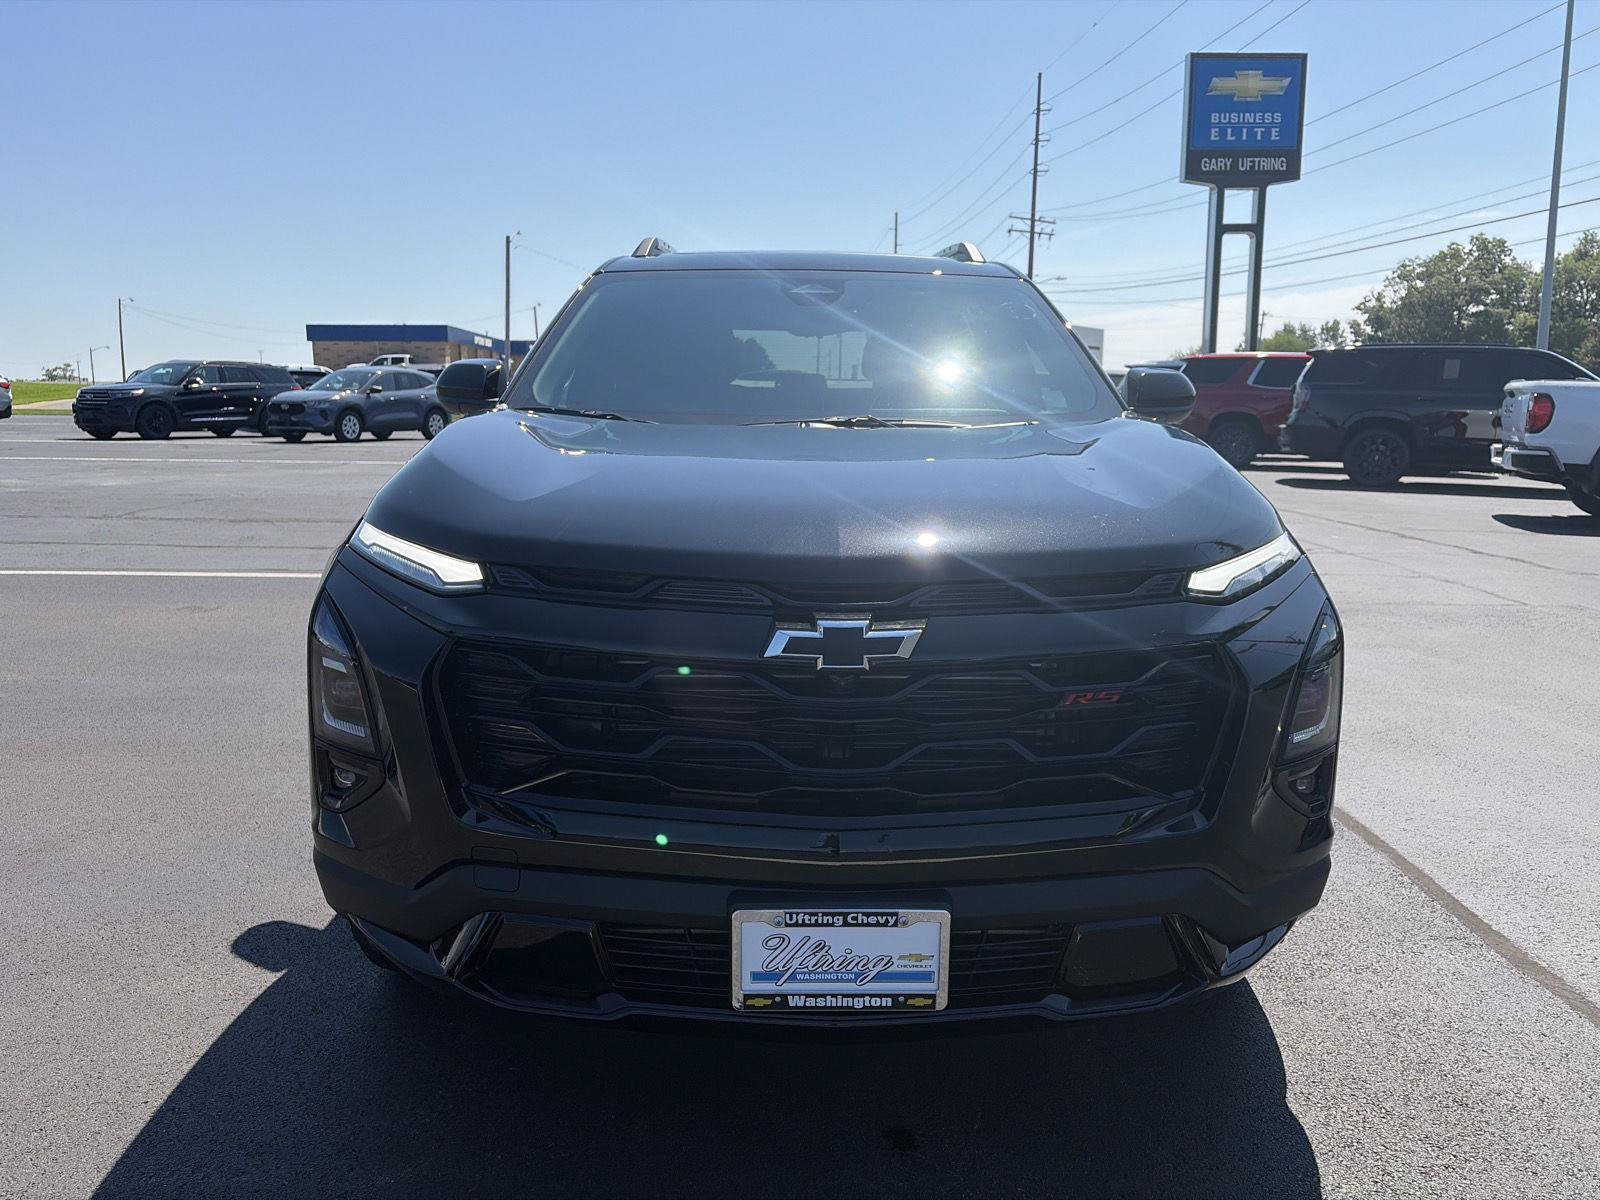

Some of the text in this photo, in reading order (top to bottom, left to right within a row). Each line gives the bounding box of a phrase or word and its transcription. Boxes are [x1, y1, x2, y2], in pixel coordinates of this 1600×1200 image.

[1211, 112, 1282, 123] BUSINESS
[1210, 127, 1280, 140] ELITE
[1201, 157, 1287, 171] GARY UFTRING
[1065, 691, 1121, 705] RS
[785, 913, 897, 926] Uftring Chevy
[762, 933, 894, 986] Uftring
[787, 995, 892, 1008] Washington
